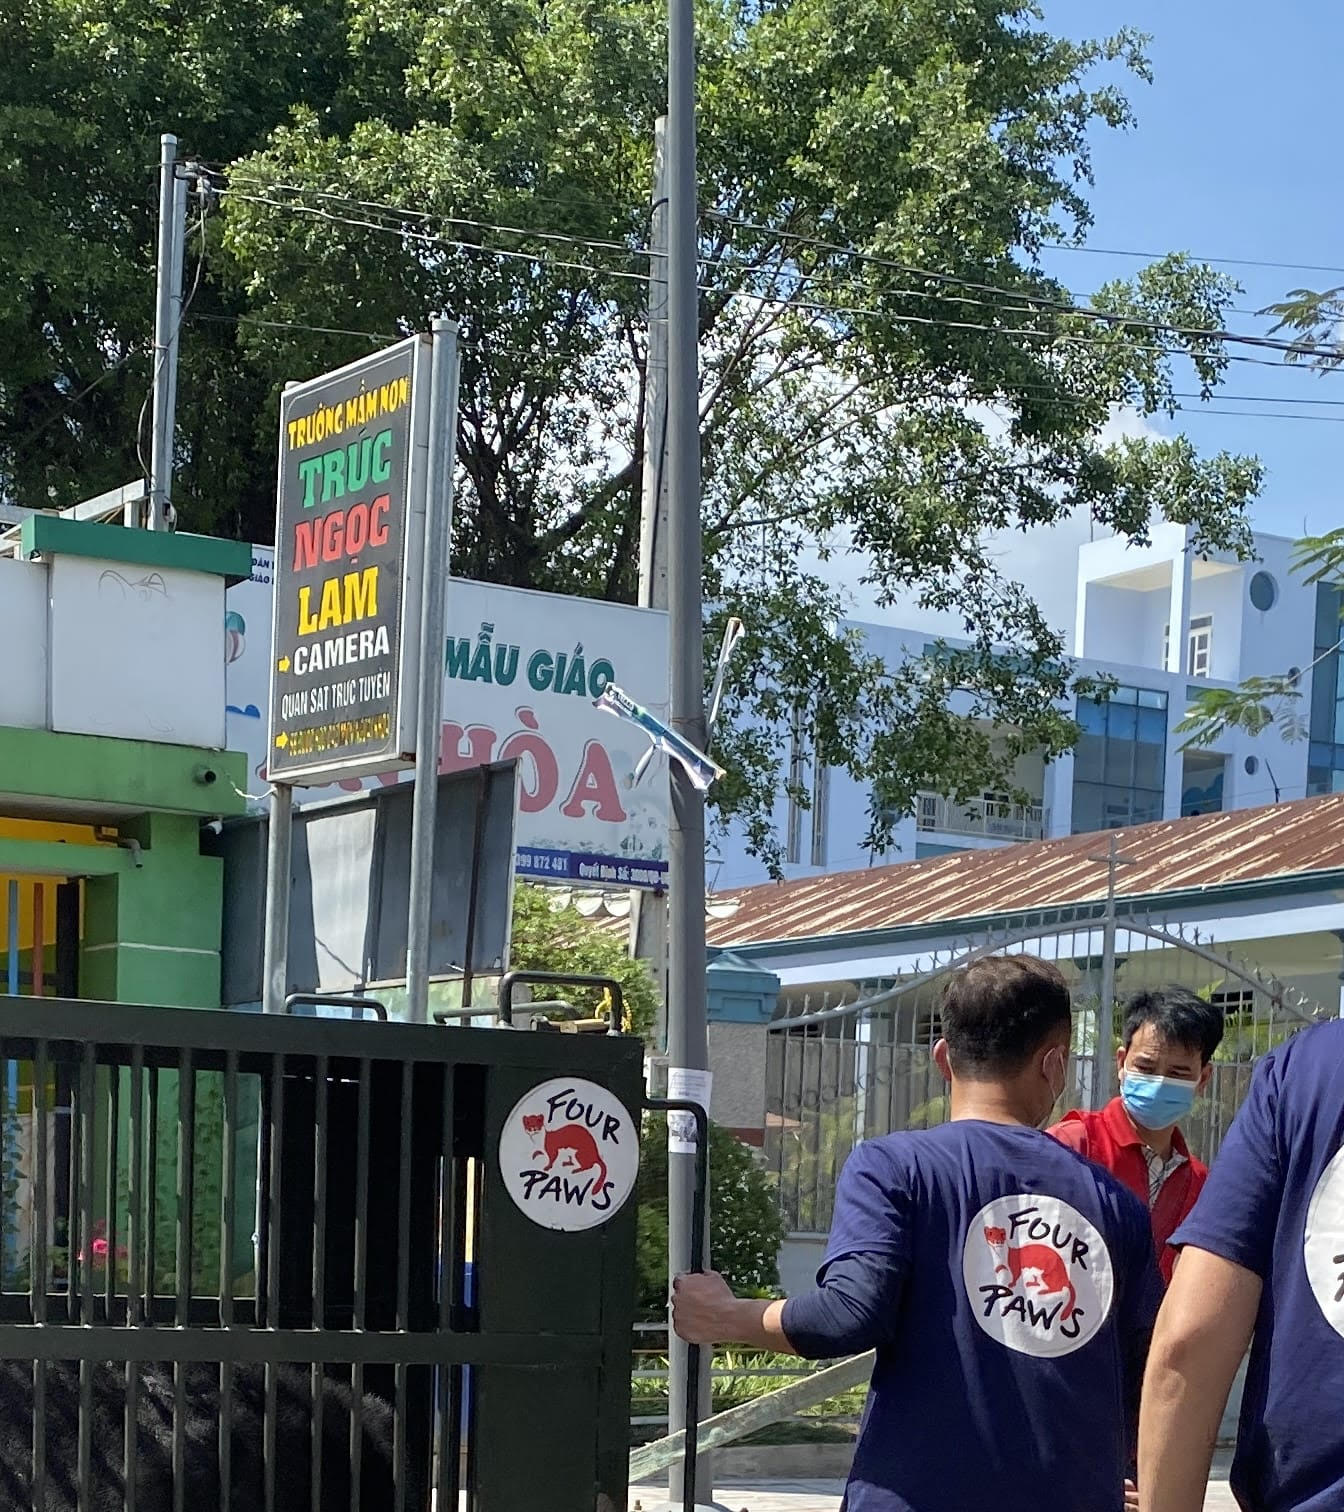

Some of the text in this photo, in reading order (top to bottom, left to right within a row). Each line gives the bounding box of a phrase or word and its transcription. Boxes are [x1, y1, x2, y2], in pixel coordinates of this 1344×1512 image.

[379, 375, 410, 417] NON
[299, 426, 392, 509] TRÚC
[293, 494, 390, 573] NGỌC
[298, 565, 379, 637] LAM
[293, 625, 390, 676] CAMERA
[445, 622, 615, 699] MẪU GIÁO
[281, 690, 308, 721] QUAN
[546, 1088, 621, 1145] FOUR
[520, 1170, 615, 1211] PAWS
[1008, 1206, 1090, 1271] FOUR
[979, 1284, 1085, 1338] PAWS
